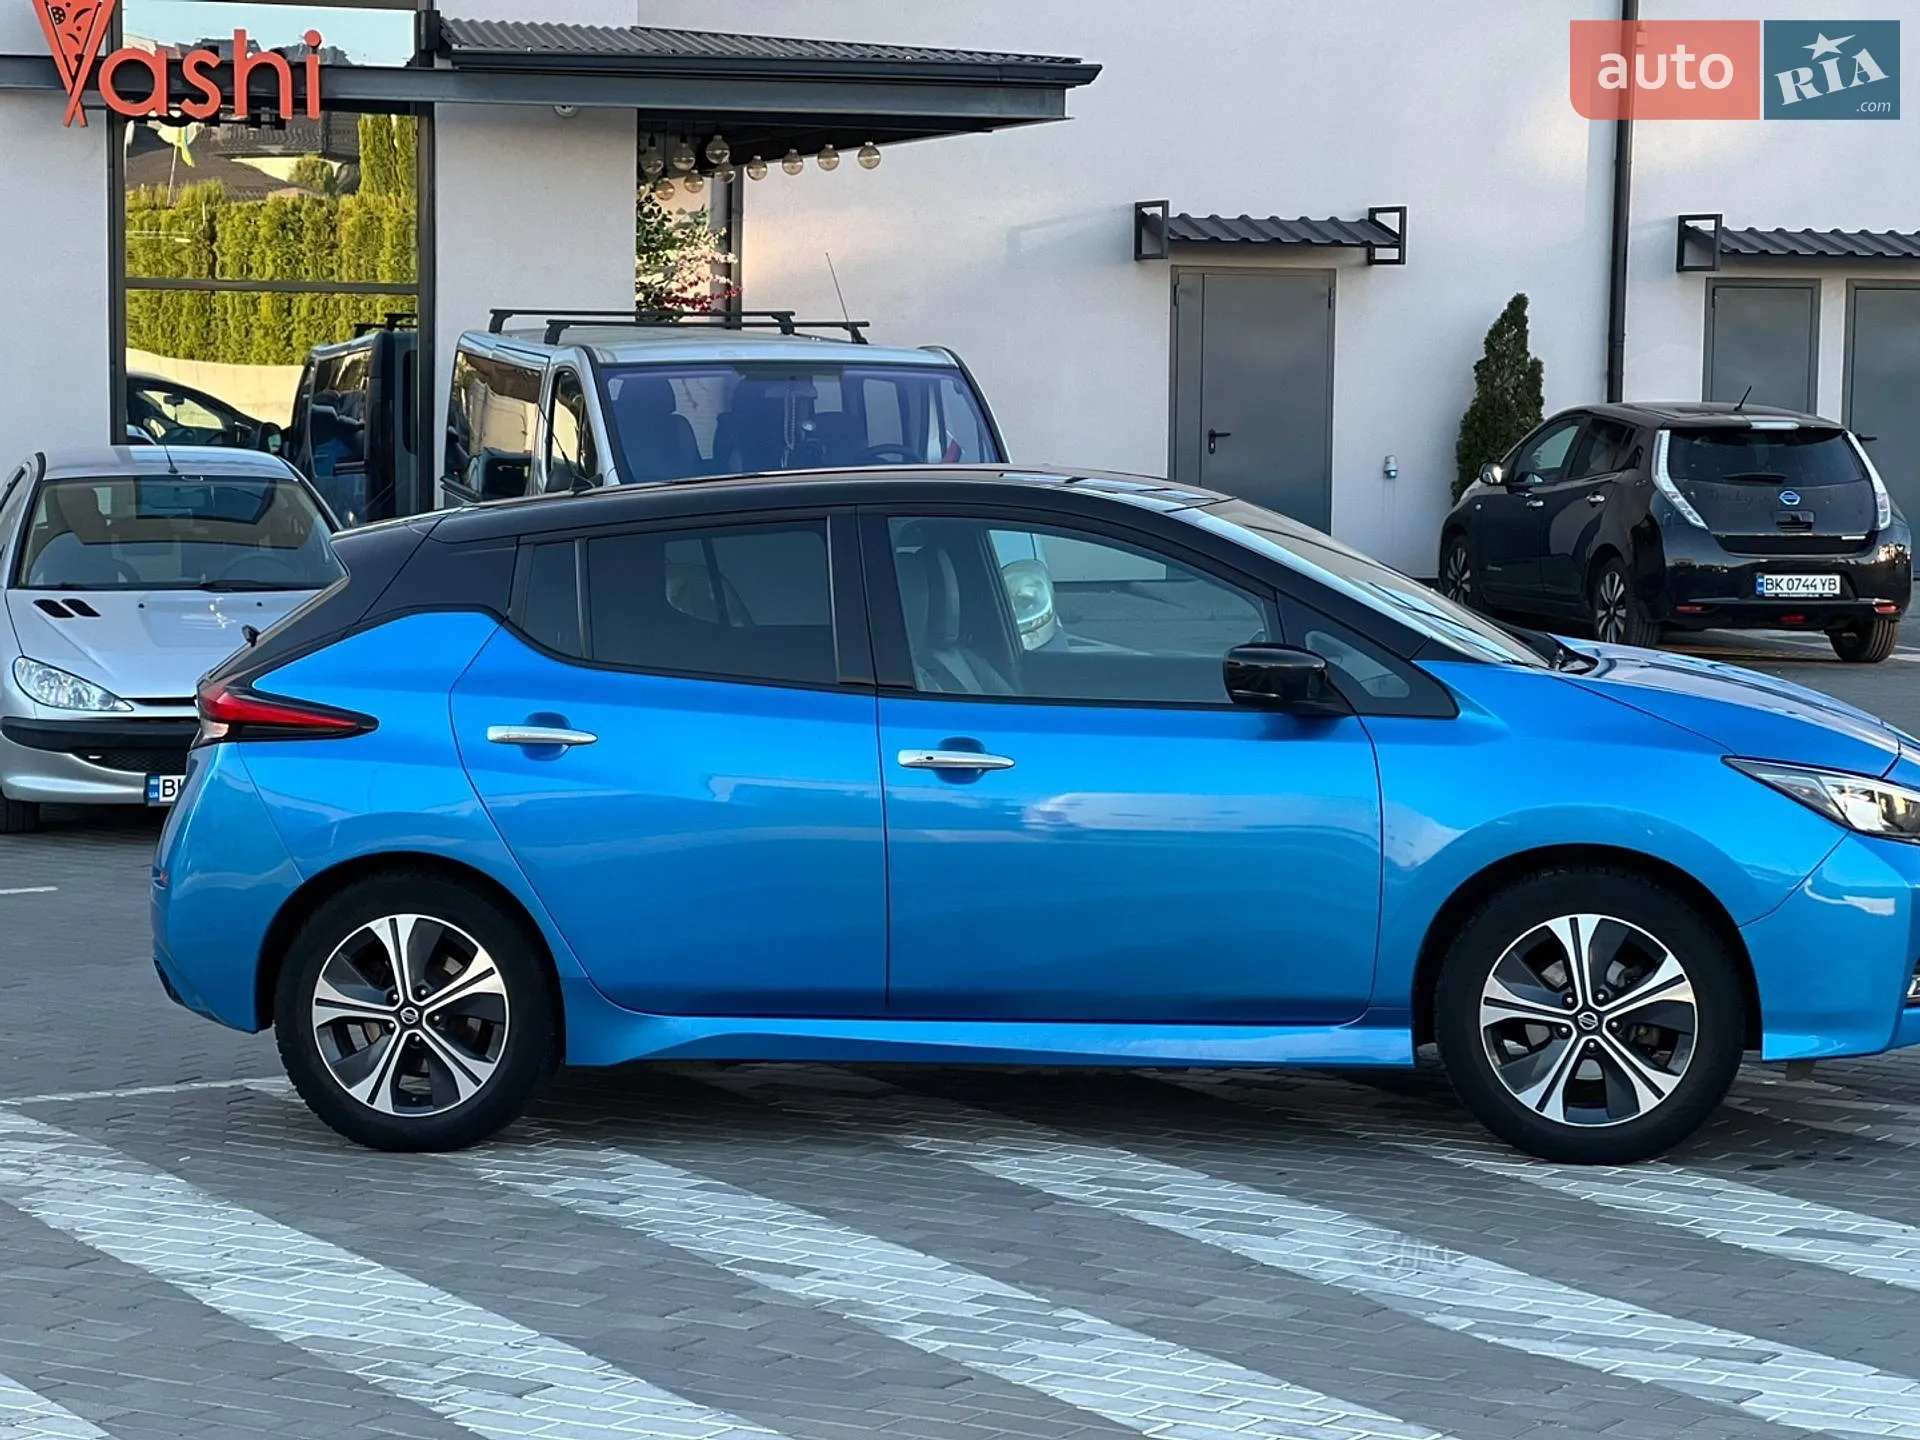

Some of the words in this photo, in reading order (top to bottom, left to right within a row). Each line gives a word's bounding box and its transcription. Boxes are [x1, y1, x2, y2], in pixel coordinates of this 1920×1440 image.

[1765, 578, 1783, 591] BK
[1786, 578, 1817, 591] 0744
[1820, 578, 1837, 591] YB
